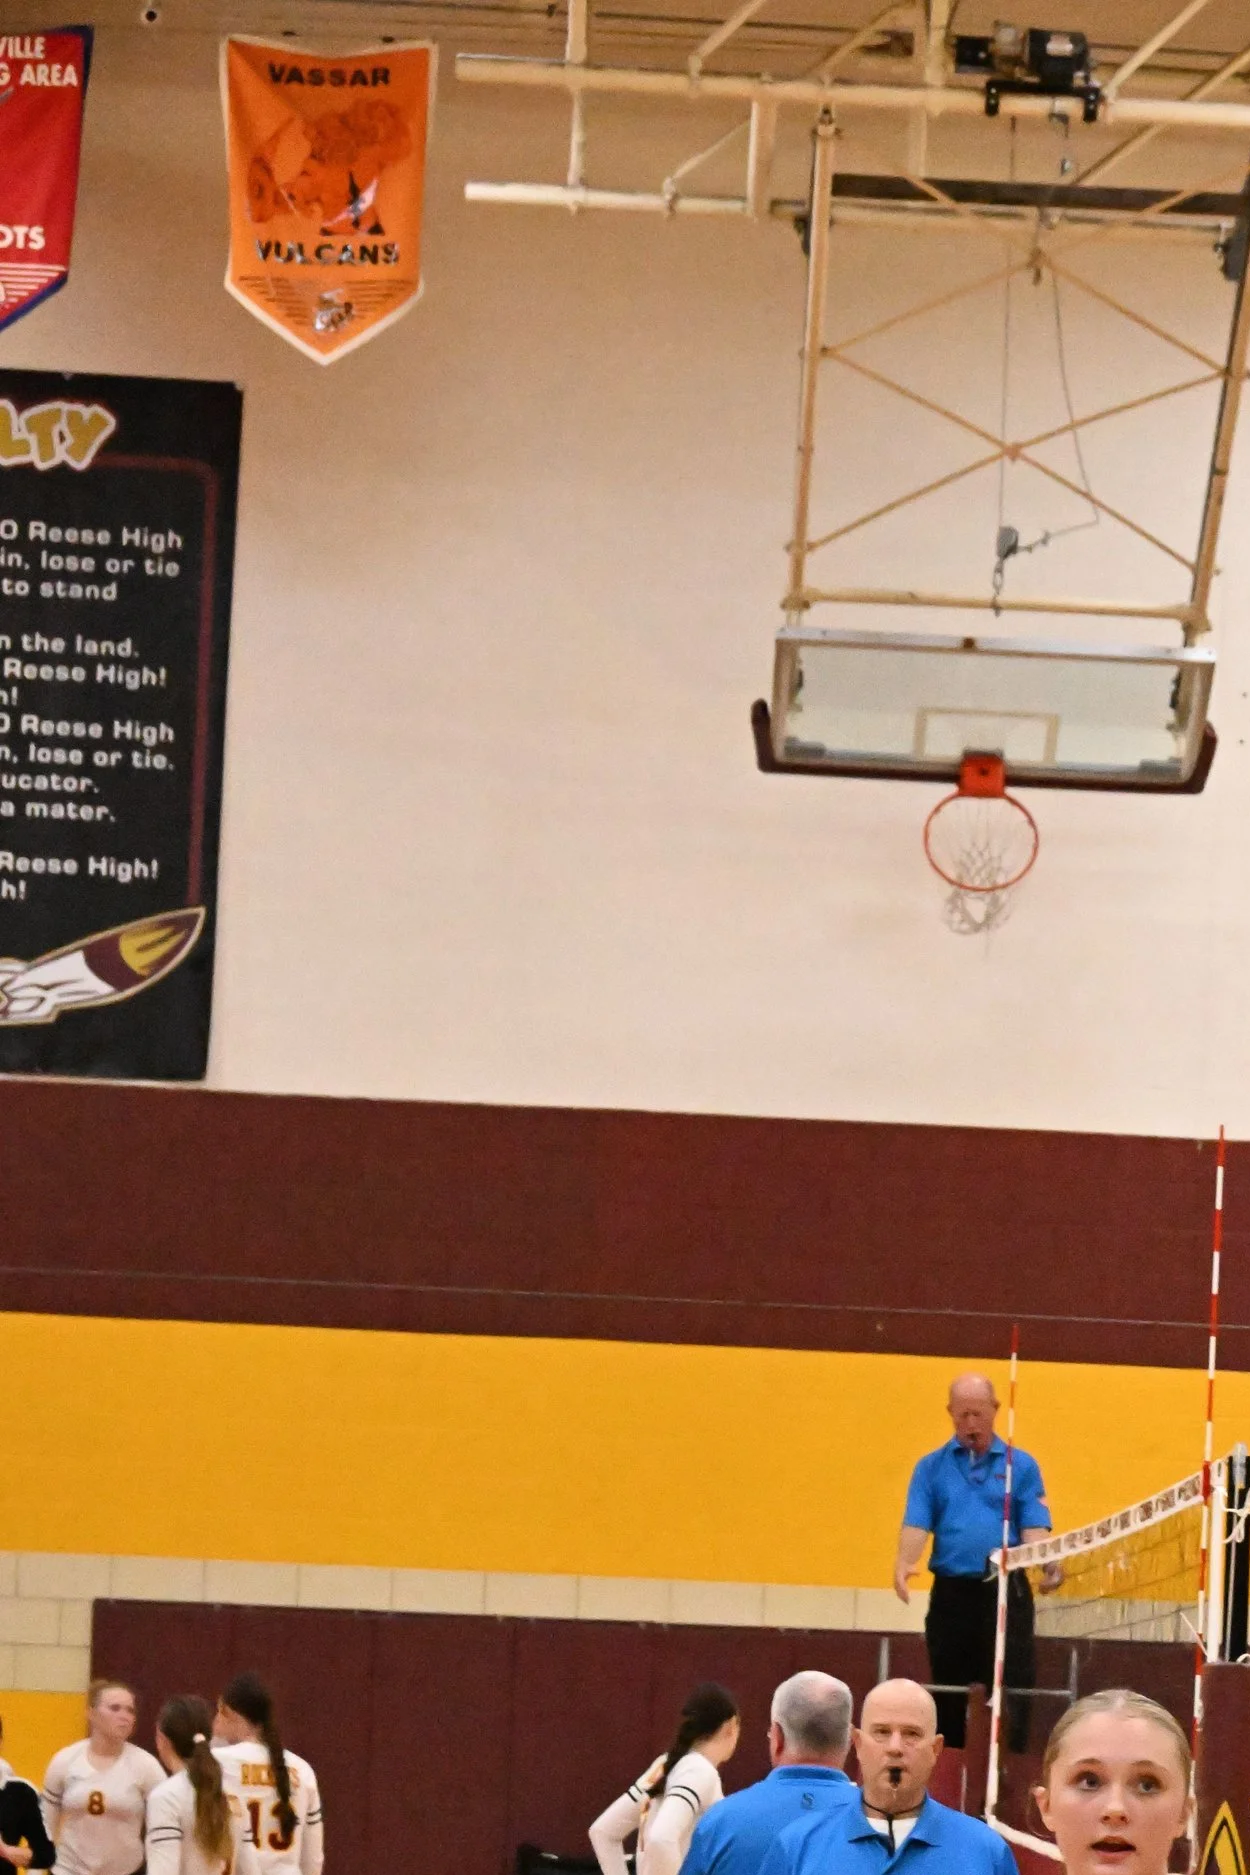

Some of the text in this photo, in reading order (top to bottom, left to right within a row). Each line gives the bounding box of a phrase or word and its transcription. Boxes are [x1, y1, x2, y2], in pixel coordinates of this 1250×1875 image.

[19, 63, 78, 87] AREA
[269, 63, 391, 87] VASSAR
[257, 239, 400, 266] VULCANS
[0, 399, 116, 471] LTY
[29, 521, 111, 546] Reese
[122, 526, 183, 554] High
[41, 549, 96, 573] lose
[105, 558, 135, 574] or
[144, 556, 180, 578] tie
[2, 577, 117, 601] to stand
[21, 631, 65, 653] the
[3, 657, 166, 690] Reese High!
[21, 714, 103, 739] Reese
[113, 719, 174, 747] High
[29, 741, 83, 766] lose
[93, 750, 122, 767] or
[0, 851, 158, 883] Reese High!
[87, 1789, 105, 1816] 8
[246, 1798, 297, 1854] 13
